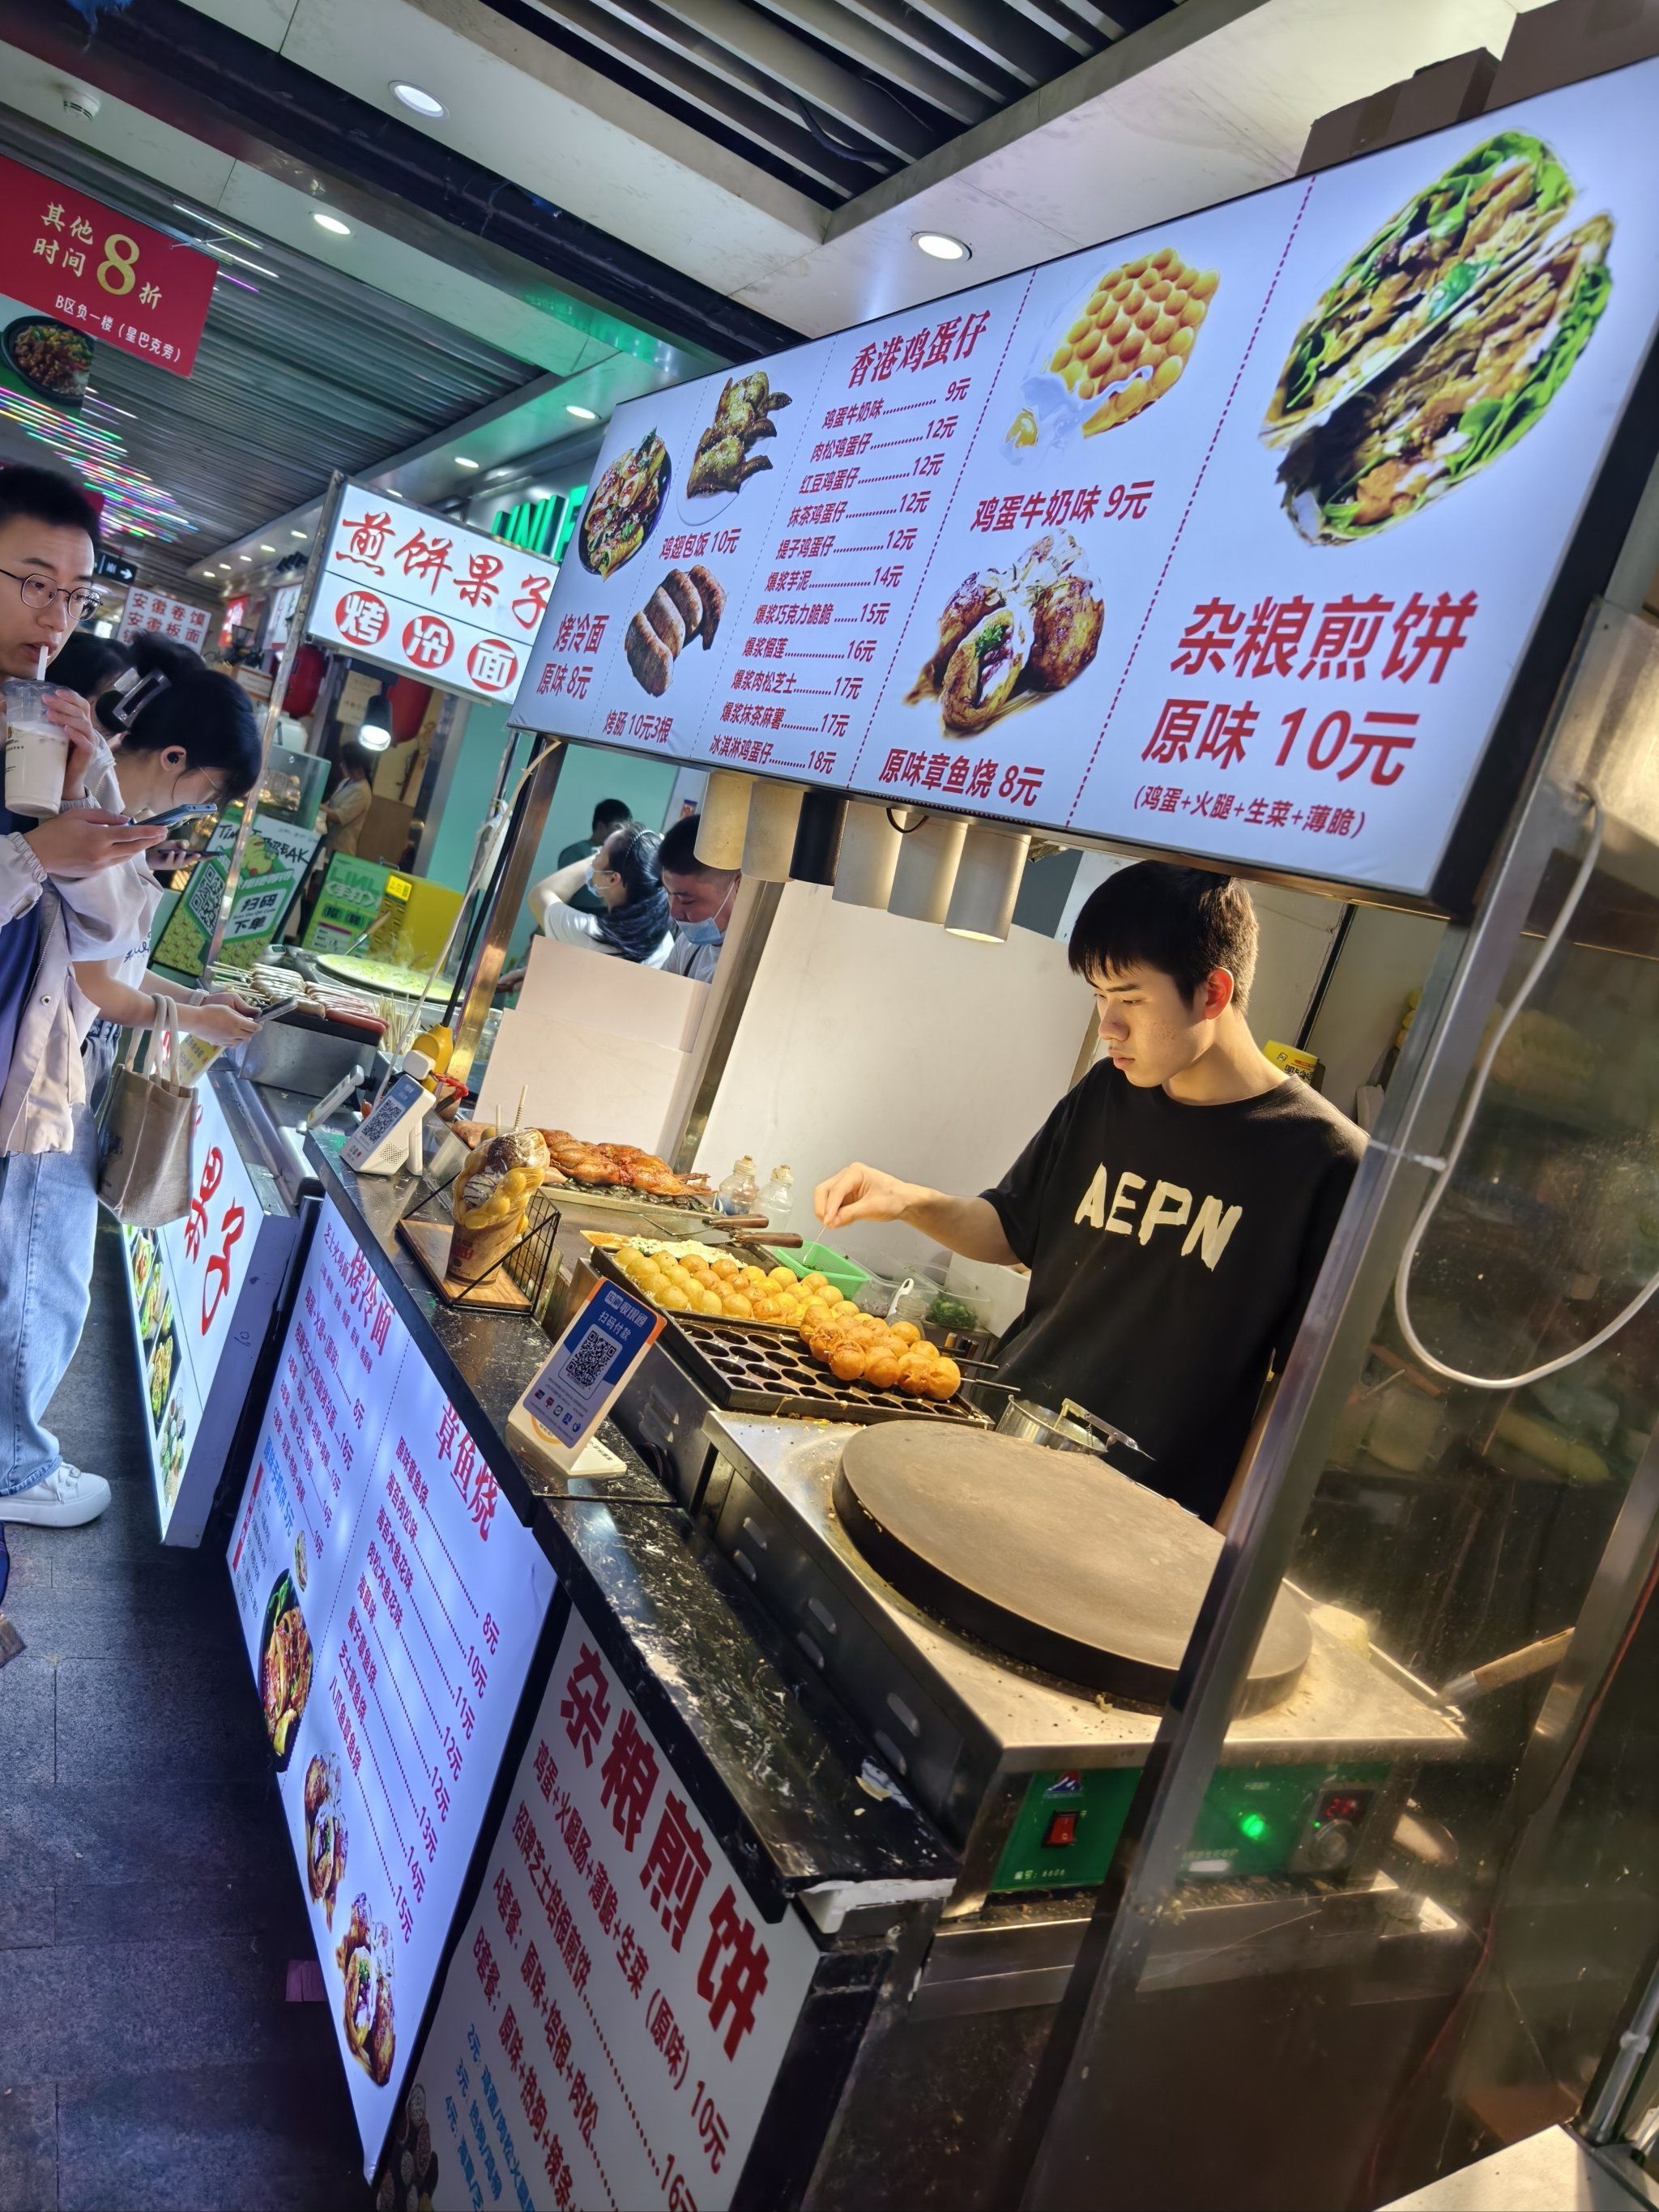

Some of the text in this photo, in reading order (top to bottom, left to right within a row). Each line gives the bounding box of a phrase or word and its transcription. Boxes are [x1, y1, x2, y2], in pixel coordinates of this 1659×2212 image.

[41, 202, 93, 245] 其他
[32, 238, 87, 278] 时间
[847, 309, 991, 389] 香港鸡蛋仔
[821, 377, 971, 429] 鸡蛋牛奶味 9元
[810, 416, 958, 462] 肉松鸡蛋仔 12元
[799, 453, 945, 494] 红豆鸡蛋仔 12元
[787, 491, 932, 527] 抹茶鸡蛋仔 12元
[970, 479, 1155, 532] 鸡蛋牛奶味 9元
[659, 528, 741, 560] 鸡翅包饭 10元
[775, 528, 918, 560] 提子鸡蛋仔 12元
[335, 511, 552, 631] 煎饼果子
[765, 565, 904, 592] 爆浆芋泥 14元
[553, 613, 610, 654] 烤冷面
[753, 603, 890, 624] 爆浆巧克力脆脆 15元
[1169, 590, 1478, 684] 杂粮煎饼
[339, 595, 516, 688] 烤冷面
[742, 637, 876, 662] 爆浆榴莲 16元
[536, 663, 594, 699] 原味 8元
[731, 669, 864, 699] 爆浆肉松芝士 17元
[603, 710, 674, 743] 烤肠 10元3根
[719, 701, 850, 737] 爆浆抹茶麻薯 17元
[1141, 697, 1421, 786] 原味 10元
[709, 734, 836, 774] 冰淇淋鸡蛋仔 18元
[879, 748, 1046, 808] 原味章鱼烧 8元
[235, 915, 267, 935] 下单
[241, 893, 279, 913] 扫码
[1074, 1161, 1243, 1272] AEPN
[346, 1252, 394, 1354] 烤冷面
[599, 1311, 631, 1341] 扫码付款
[353, 1398, 365, 1430] 8元
[340, 1432, 353, 1471] 18元
[437, 1401, 502, 1539] 章鱼烧
[284, 1500, 294, 1536] 5元
[396, 1436, 499, 1655] 原味章鱼烧 8元
[386, 1471, 487, 1698] 海苔肉松味 10元
[377, 1506, 475, 1740] 海苔木鱼花味 11元
[367, 1541, 462, 1781] 肉松木鱼花味 12元
[357, 1572, 450, 1822] 海草味 12元
[348, 1606, 437, 1862] 蟹子章鱼烧 13元
[339, 1640, 424, 1903] 芝士章鱼烧 14元
[329, 1677, 412, 1943] 八爪鱼章鱼烧 15元
[560, 1642, 770, 2062] 杂粮煎饼
[513, 1800, 591, 1997] 招牌芝士培根煎饼
[521, 1941, 599, 2148] 原味+培根+肉松
[499, 2004, 583, 2212] 原味+热狗+辣条+
[691, 2081, 729, 2174] 10元
